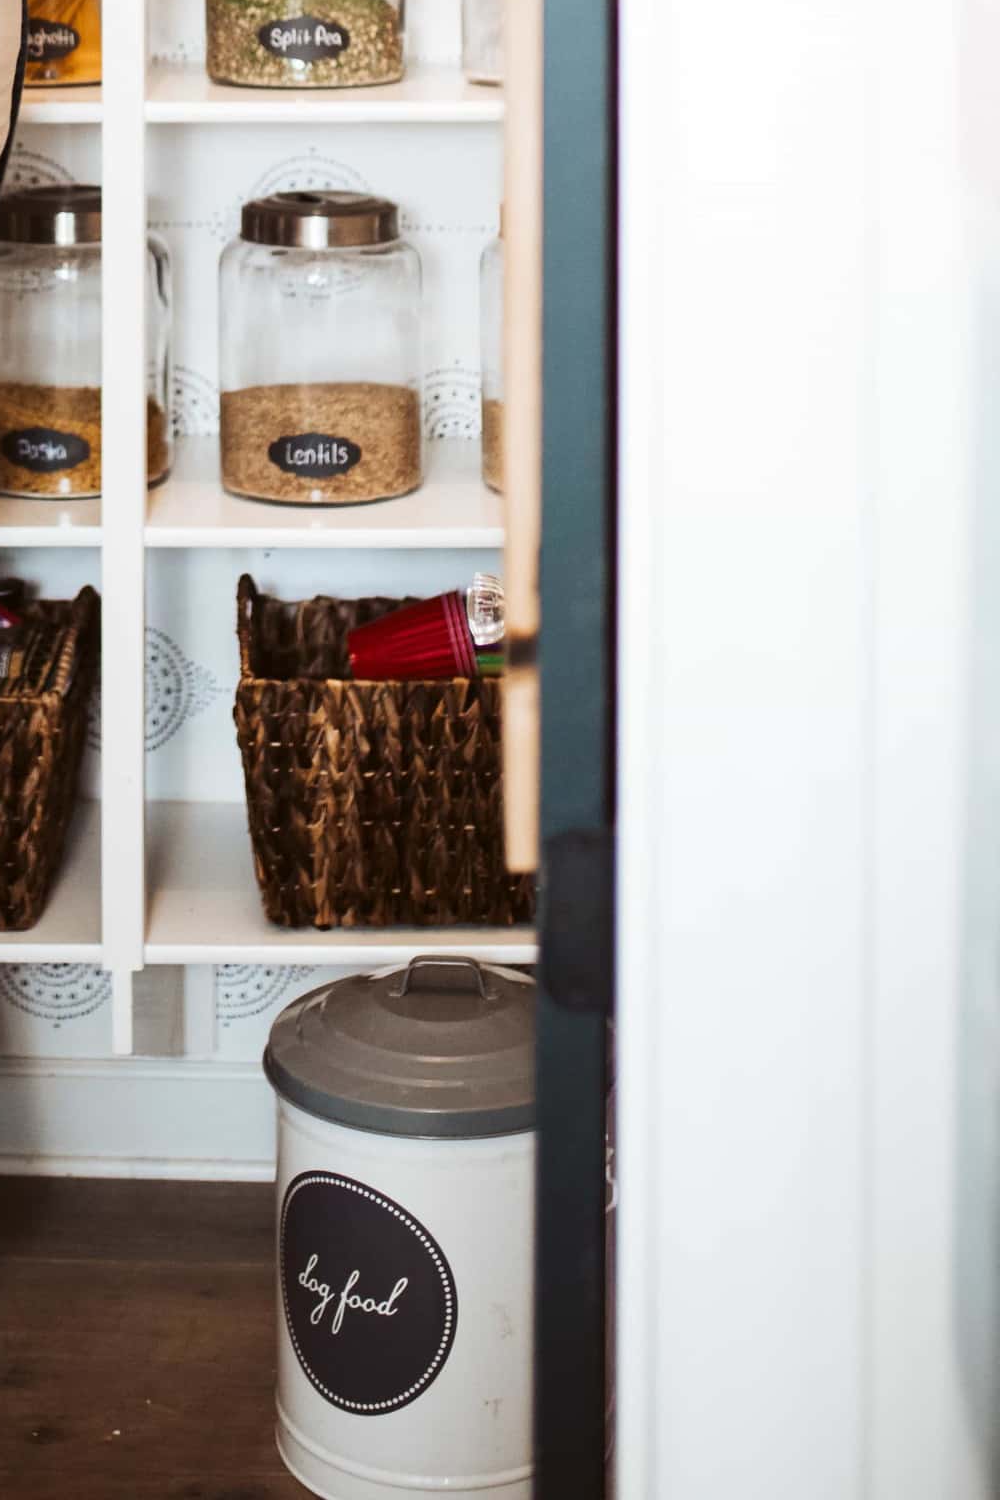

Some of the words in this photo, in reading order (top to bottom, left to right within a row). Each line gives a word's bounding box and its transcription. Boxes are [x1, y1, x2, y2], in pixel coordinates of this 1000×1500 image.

[270, 27, 312, 51] Split
[285, 443, 350, 465] Lentils
[299, 1253, 335, 1325] dog
[331, 1269, 409, 1336] food
